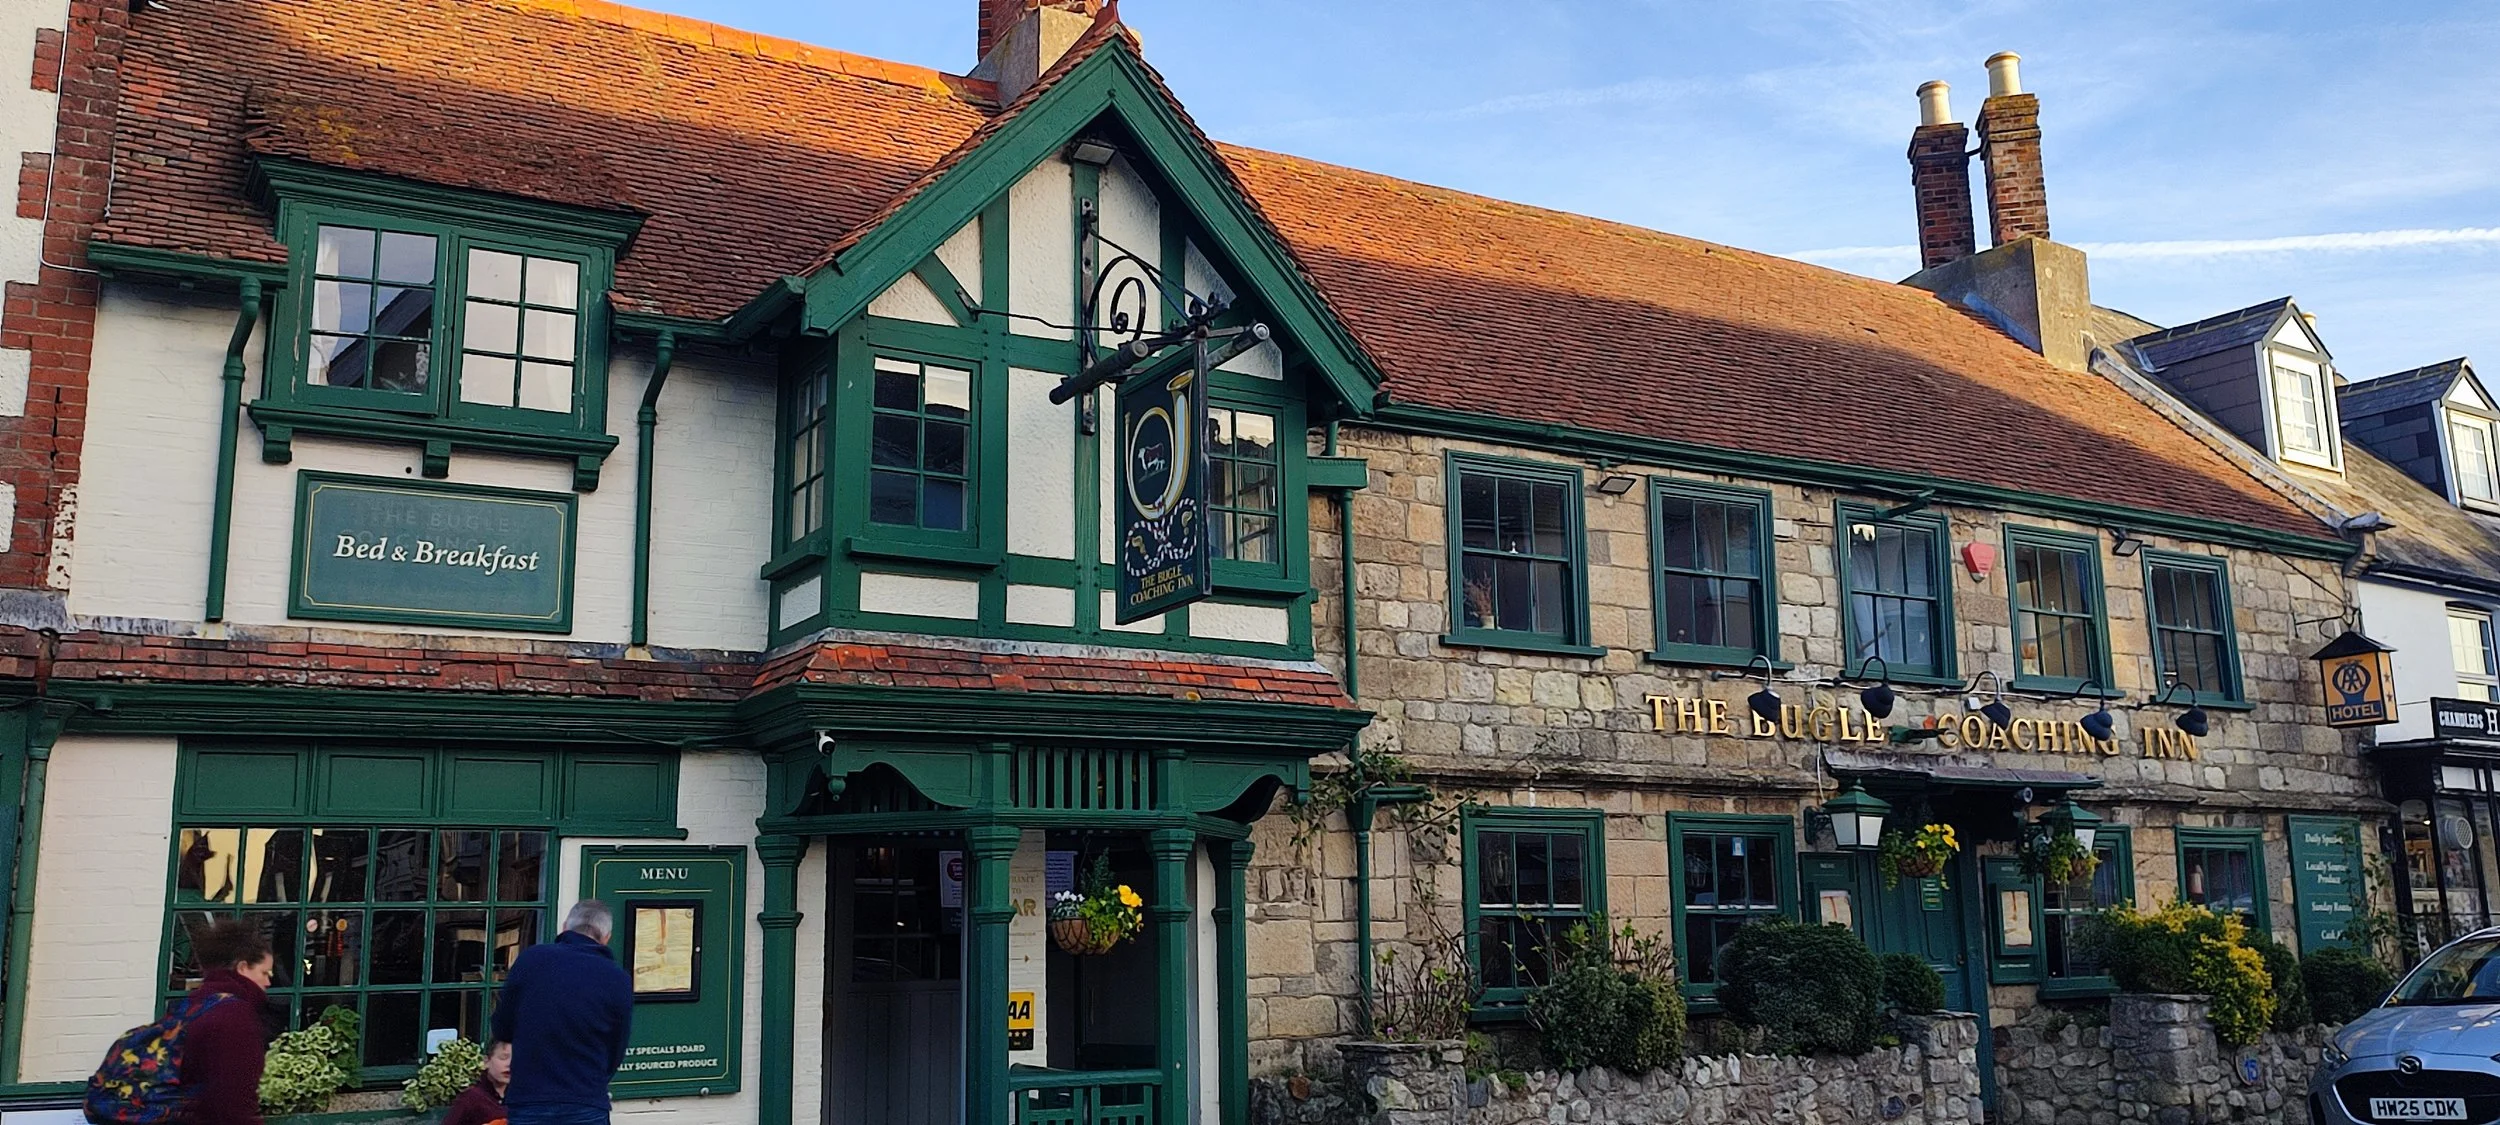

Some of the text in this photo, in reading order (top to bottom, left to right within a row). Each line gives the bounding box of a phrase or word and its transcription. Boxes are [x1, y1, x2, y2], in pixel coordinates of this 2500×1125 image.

[333, 535, 388, 562] Bed
[391, 544, 408, 562] &
[412, 540, 540, 576] Breakfast
[1141, 564, 1183, 589] THE BUGLE
[1130, 574, 1194, 606] COACHING INN
[2331, 703, 2380, 719] HOTEL
[1645, 694, 1730, 735] THE
[2142, 726, 2199, 760] INN
[2439, 710, 2484, 730] CHANDLERS
[2305, 833, 2321, 846] Daily
[640, 867, 690, 880] MENU
[2306, 861, 2327, 873] Locally
[2318, 874, 2341, 884] Produce
[1012, 899, 1036, 917] AR
[2312, 901, 2333, 914] Sunday
[636, 1045, 675, 1056] SPECIALS
[676, 1044, 706, 1054] BOARD
[635, 1060, 676, 1071] SOURCED
[677, 1058, 718, 1069] PRODUCE
[2377, 1100, 2459, 1117] HW25 CDK
